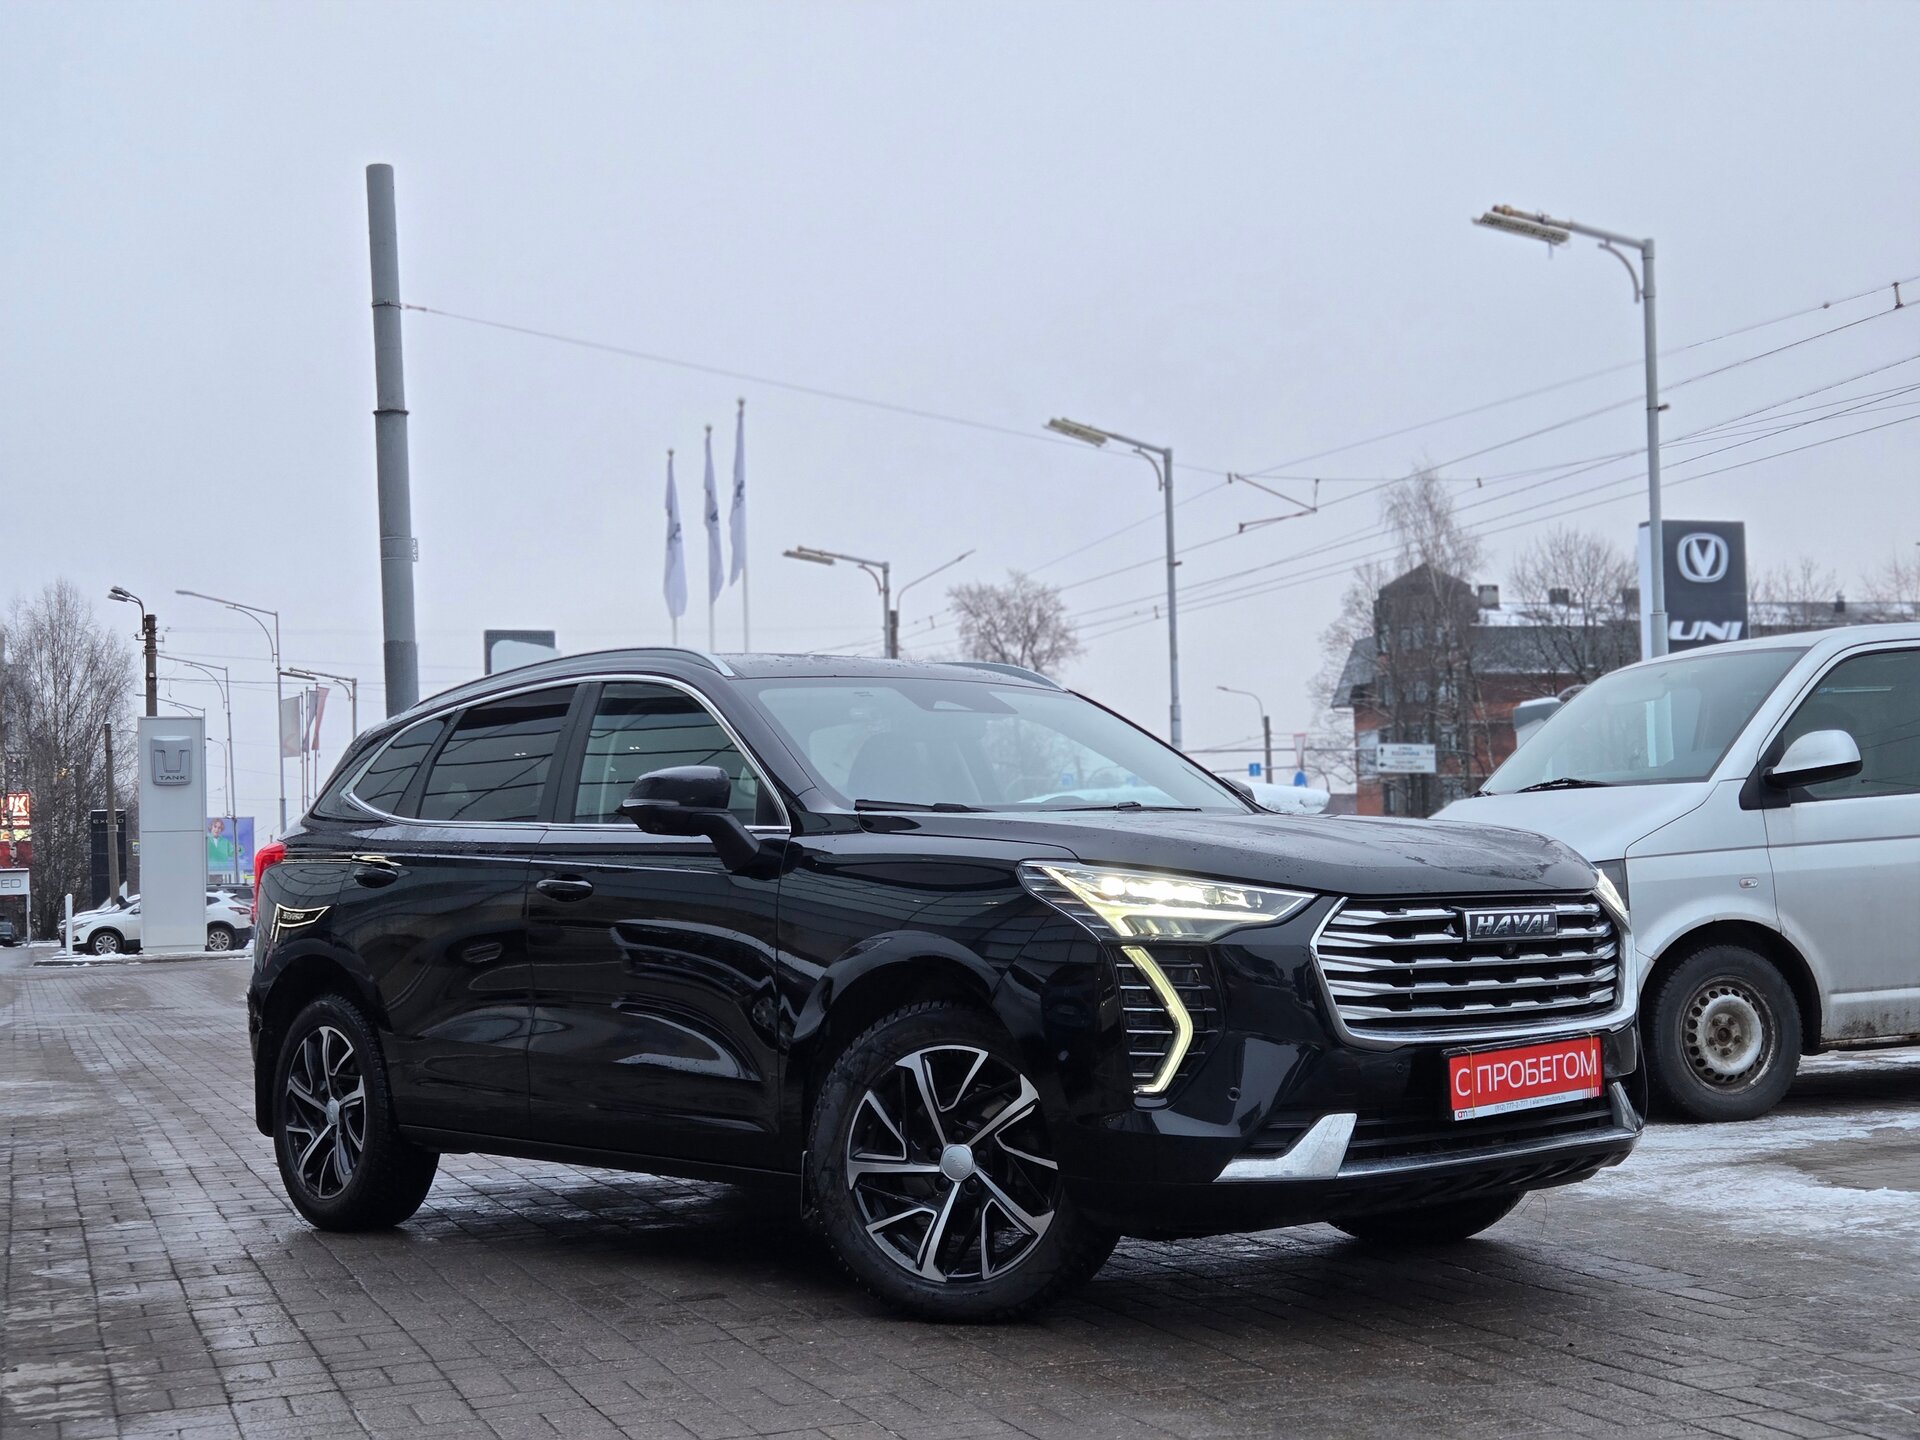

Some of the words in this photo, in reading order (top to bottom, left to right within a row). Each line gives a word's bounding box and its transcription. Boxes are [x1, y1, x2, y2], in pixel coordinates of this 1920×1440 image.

[1668, 621, 1743, 641] UNI
[1475, 914, 1556, 935] HAVAL
[1455, 1067, 1472, 1097] С
[1476, 1049, 1598, 1094] ПРОБЕГОМ
